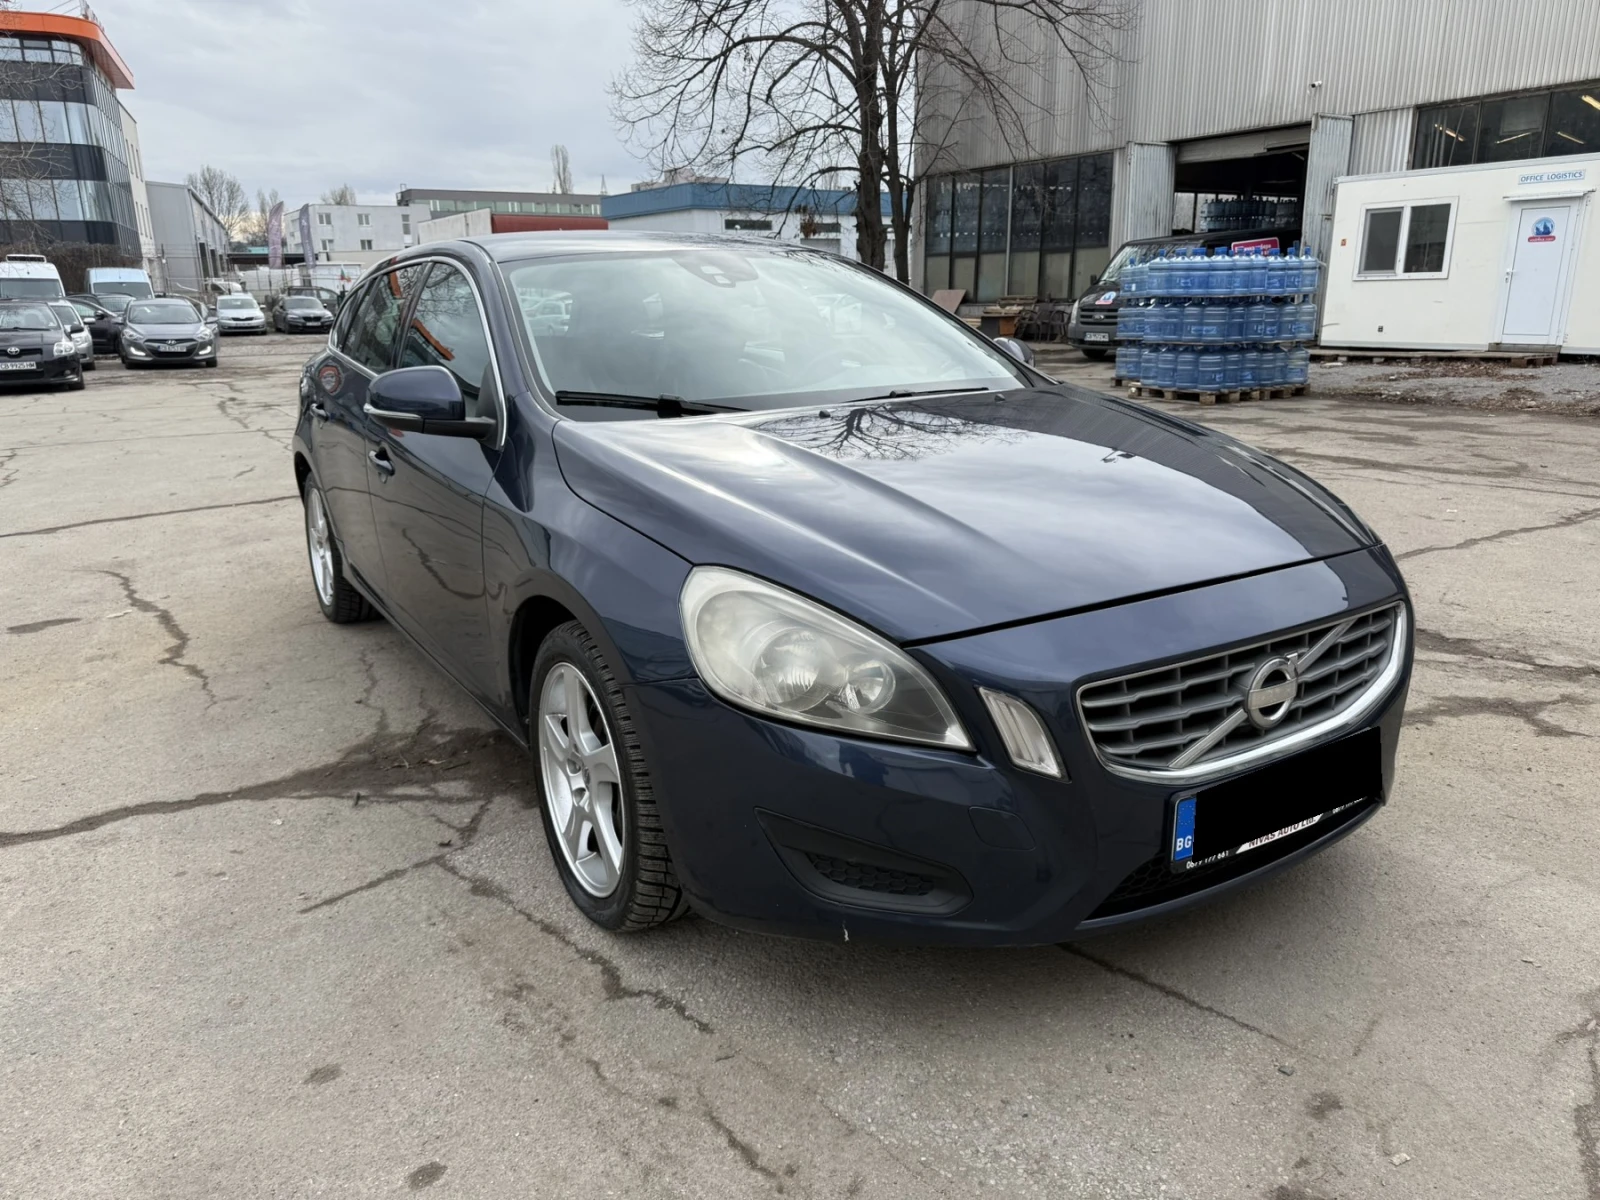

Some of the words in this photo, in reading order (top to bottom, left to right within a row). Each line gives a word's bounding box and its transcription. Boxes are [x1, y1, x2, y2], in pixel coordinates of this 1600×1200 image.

[1520, 174, 1544, 183] OFFICE
[1547, 171, 1583, 180] LOGISTICS
[1176, 835, 1192, 851] BG
[1249, 833, 1276, 848] NIVAS
[1277, 823, 1299, 837] AUTO
